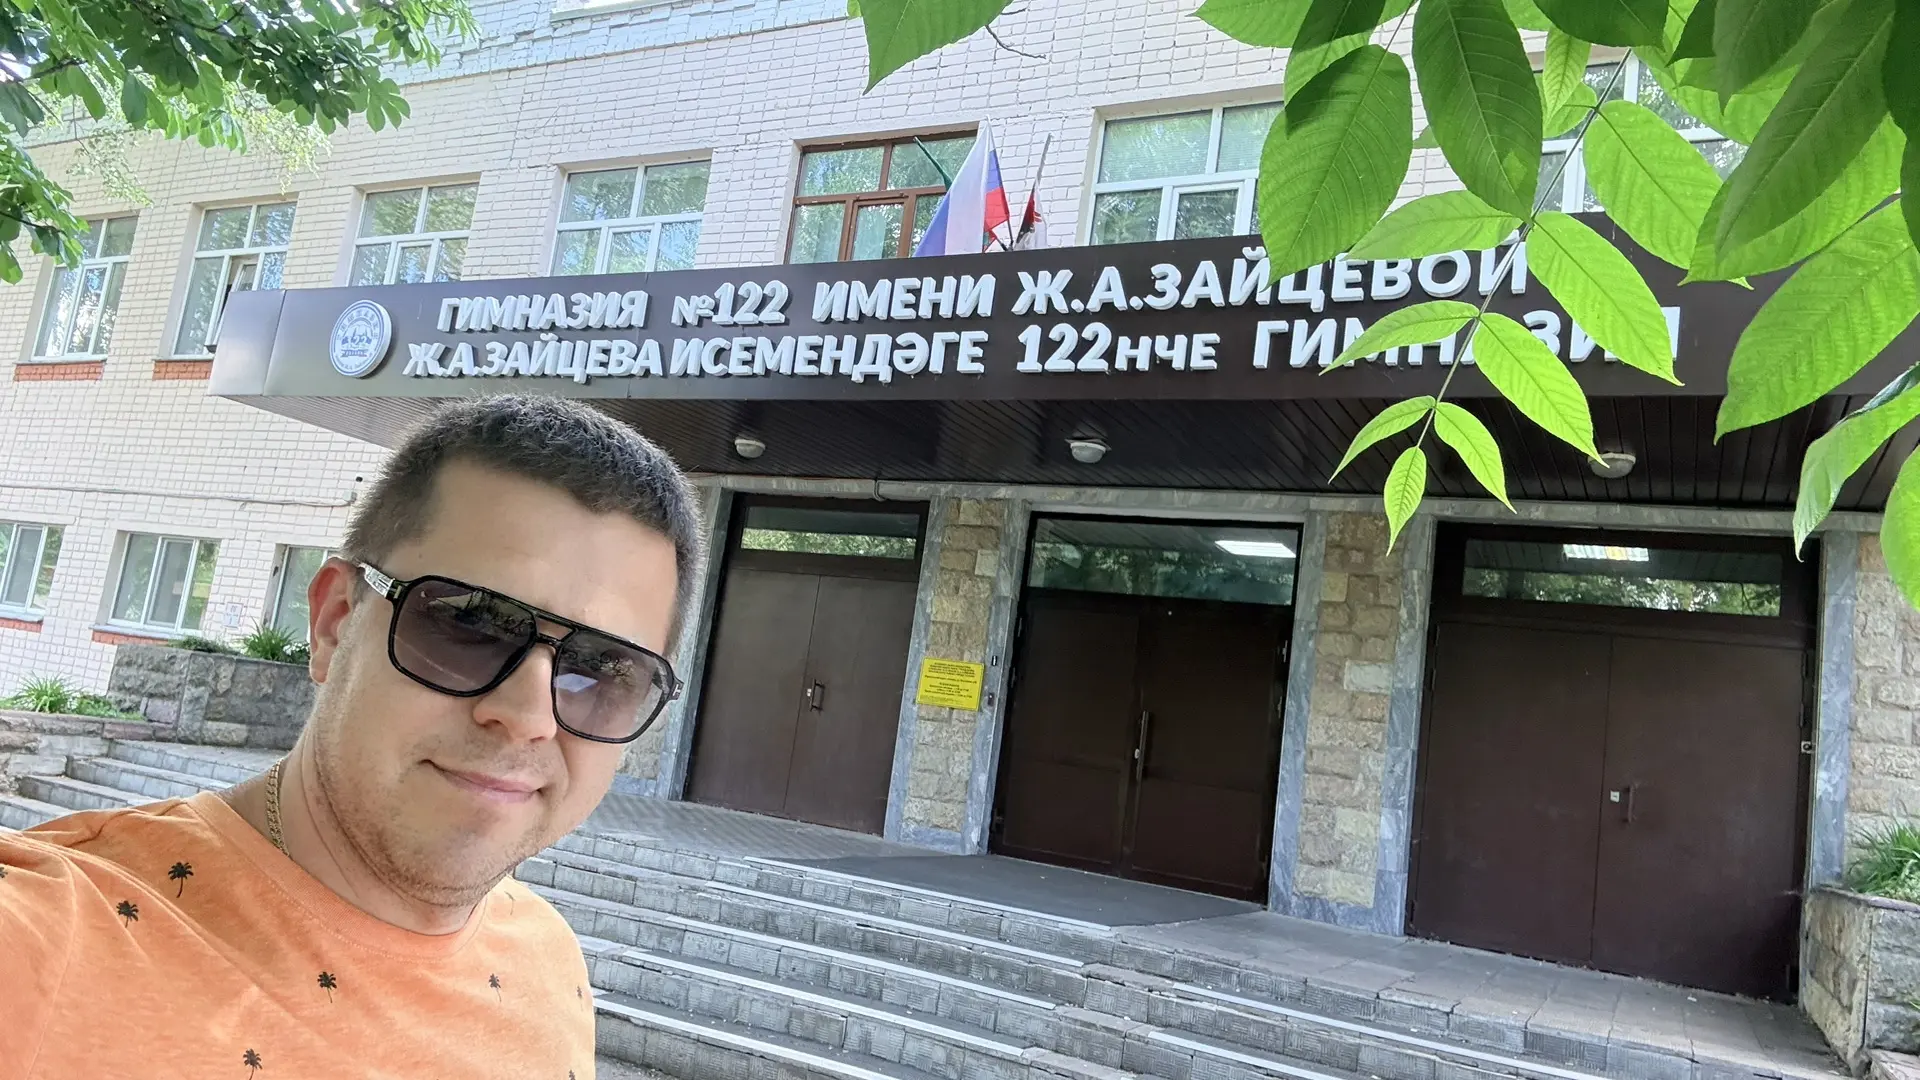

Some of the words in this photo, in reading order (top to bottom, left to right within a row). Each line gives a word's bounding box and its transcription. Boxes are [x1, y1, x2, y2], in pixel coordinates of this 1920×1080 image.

[437, 290, 648, 332] ГИМНАЗИЯ
[671, 280, 790, 326] №122
[812, 274, 997, 322] ИМЕНИ
[402, 333, 664, 384] Ж.А.ЗАЙЦЕВА
[670, 330, 988, 384] ИСЕМЕНДӘГЕ
